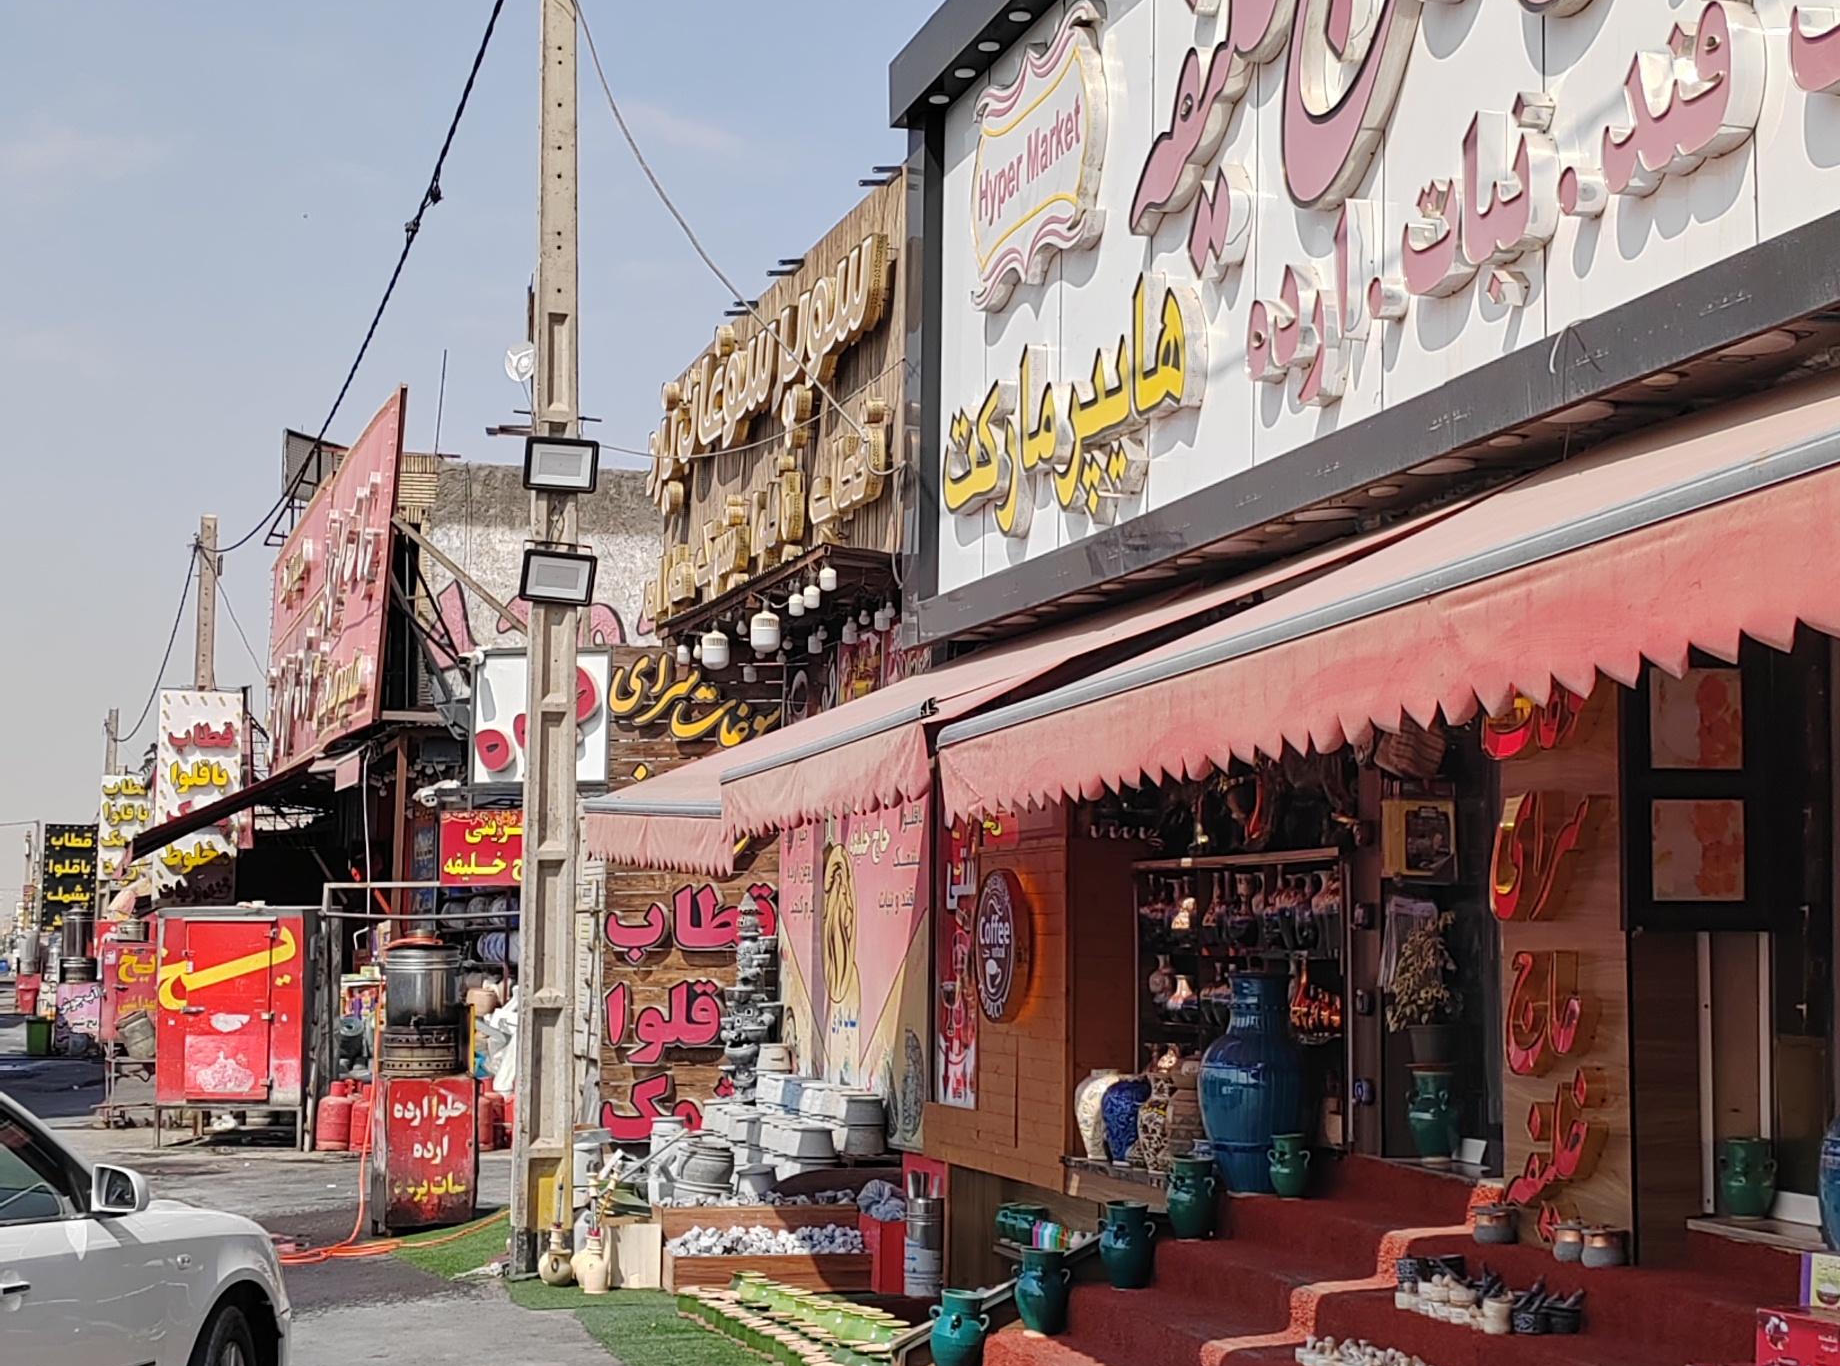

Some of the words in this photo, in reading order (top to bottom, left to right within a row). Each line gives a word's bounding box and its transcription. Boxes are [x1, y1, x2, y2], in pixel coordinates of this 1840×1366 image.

[977, 155, 1023, 227] Hyper
[1026, 103, 1082, 181] Market
[608, 652, 699, 726] سرای
[167, 721, 235, 754] قطاب
[169, 759, 229, 795] باقلوا
[50, 831, 93, 851] قطاب
[48, 858, 91, 879] باقلوا
[442, 851, 507, 882] خلیفه
[979, 914, 1011, 945] Coffee
[117, 947, 157, 984] یخ
[157, 925, 297, 1011] یخ
[1506, 950, 1583, 1076] حاج
[393, 1095, 428, 1126] ارده
[431, 1092, 468, 1125] حلوا
[413, 1134, 449, 1165] ارده
